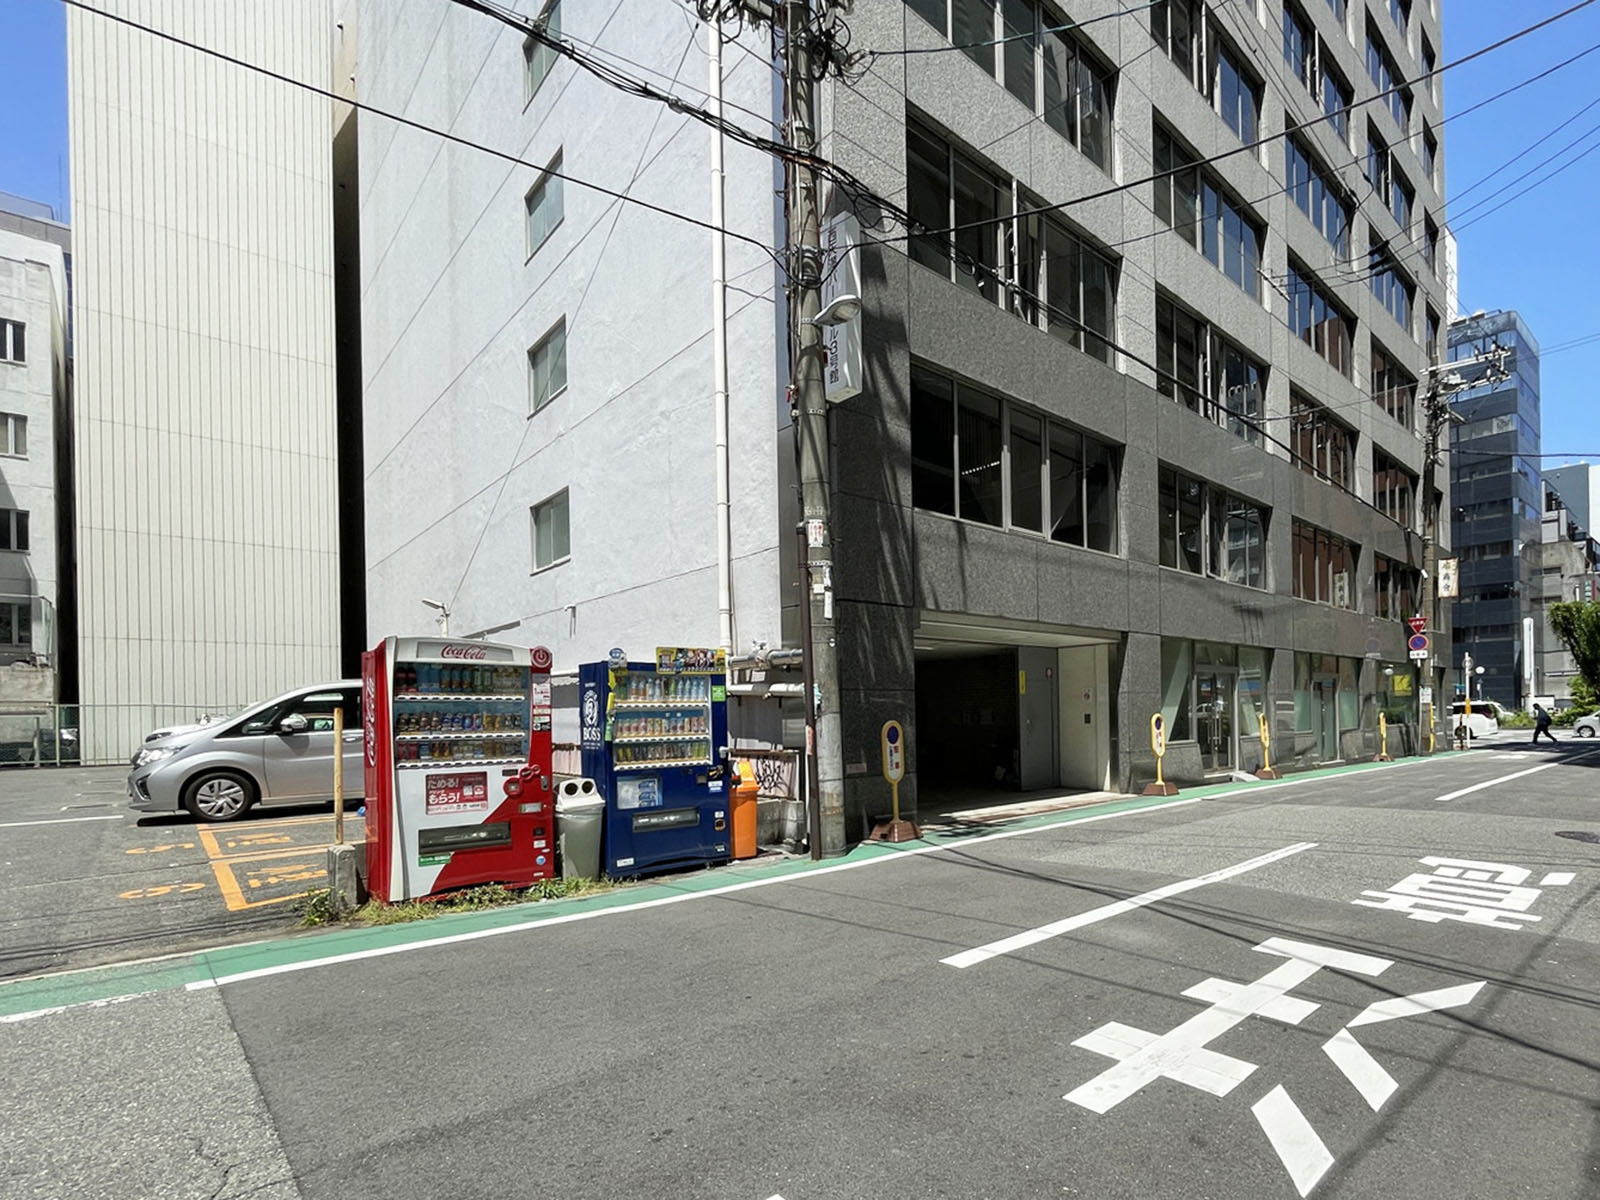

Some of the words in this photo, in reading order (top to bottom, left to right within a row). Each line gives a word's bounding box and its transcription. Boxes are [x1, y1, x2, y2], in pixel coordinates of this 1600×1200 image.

[583, 727, 601, 741] BOSS
[429, 792, 460, 804] もらう!
